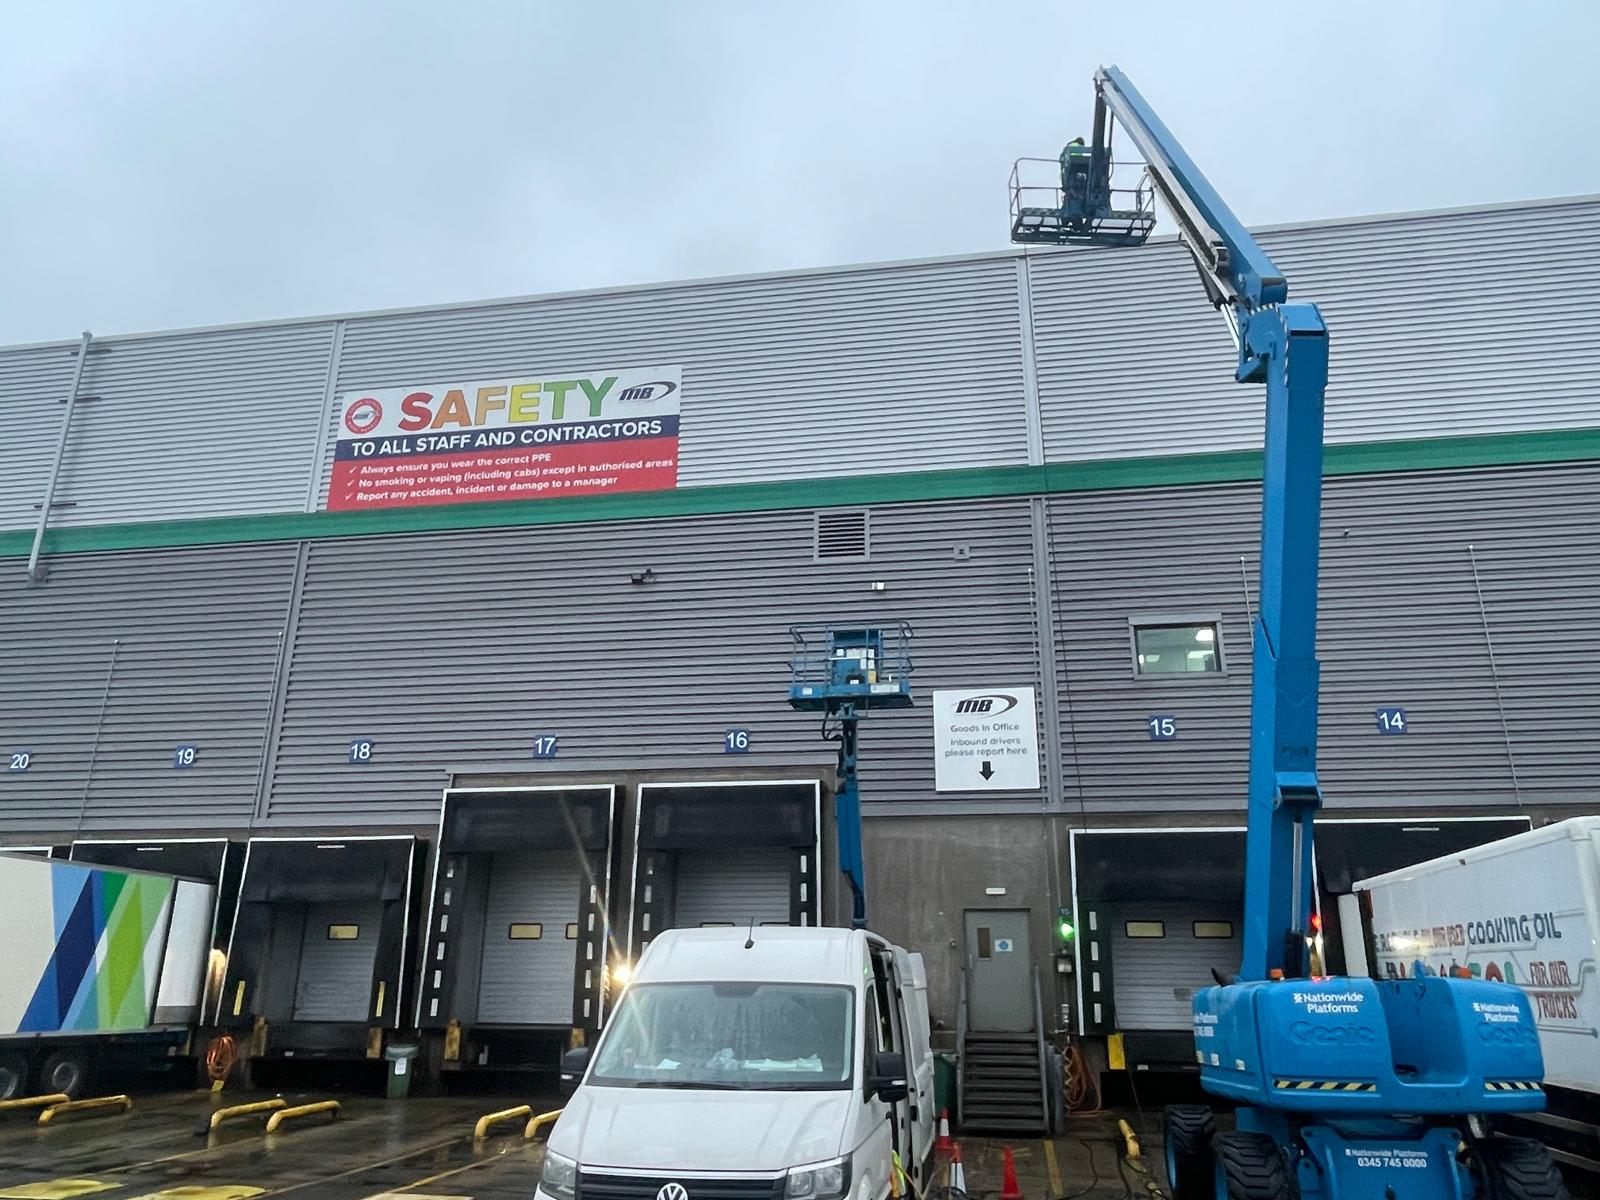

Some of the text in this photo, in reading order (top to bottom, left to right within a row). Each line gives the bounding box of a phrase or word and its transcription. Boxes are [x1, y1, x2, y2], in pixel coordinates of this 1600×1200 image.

[397, 376, 618, 432] SAFETY
[352, 420, 662, 457] TO ALL STAFF AND CONTRACTORS
[360, 453, 552, 475] Always ensure you wear the correct PPE
[358, 459, 673, 488] No smoking or vaping (including cabs) except in authorised areas
[356, 490, 390, 503] Report
[391, 491, 408, 502] any
[410, 487, 453, 497] accident,
[456, 484, 494, 494] incident
[497, 484, 507, 493] or
[510, 480, 549, 491] damage
[552, 479, 562, 488] to
[573, 476, 618, 488] manager
[950, 723, 980, 733] Goods
[992, 722, 1020, 731] Office
[1150, 718, 1175, 736] 15
[1379, 712, 1404, 730] 14
[535, 737, 555, 754] 17
[727, 731, 748, 749] 16
[950, 736, 1021, 746] Inbound drivers
[177, 748, 195, 765] 19
[351, 742, 371, 760] 18
[944, 746, 1028, 758] please report here
[10, 753, 29, 769] 20
[1467, 914, 1532, 945] COOKING
[1533, 911, 1562, 939] OIL
[1529, 960, 1549, 986] FOR
[1549, 960, 1572, 986] OUR
[1303, 992, 1364, 1003] Nationwide
[1534, 991, 1577, 1020] TRUCKS
[1307, 1003, 1359, 1014] Platforms
[1357, 1157, 1427, 1168] 0345 745 0000
